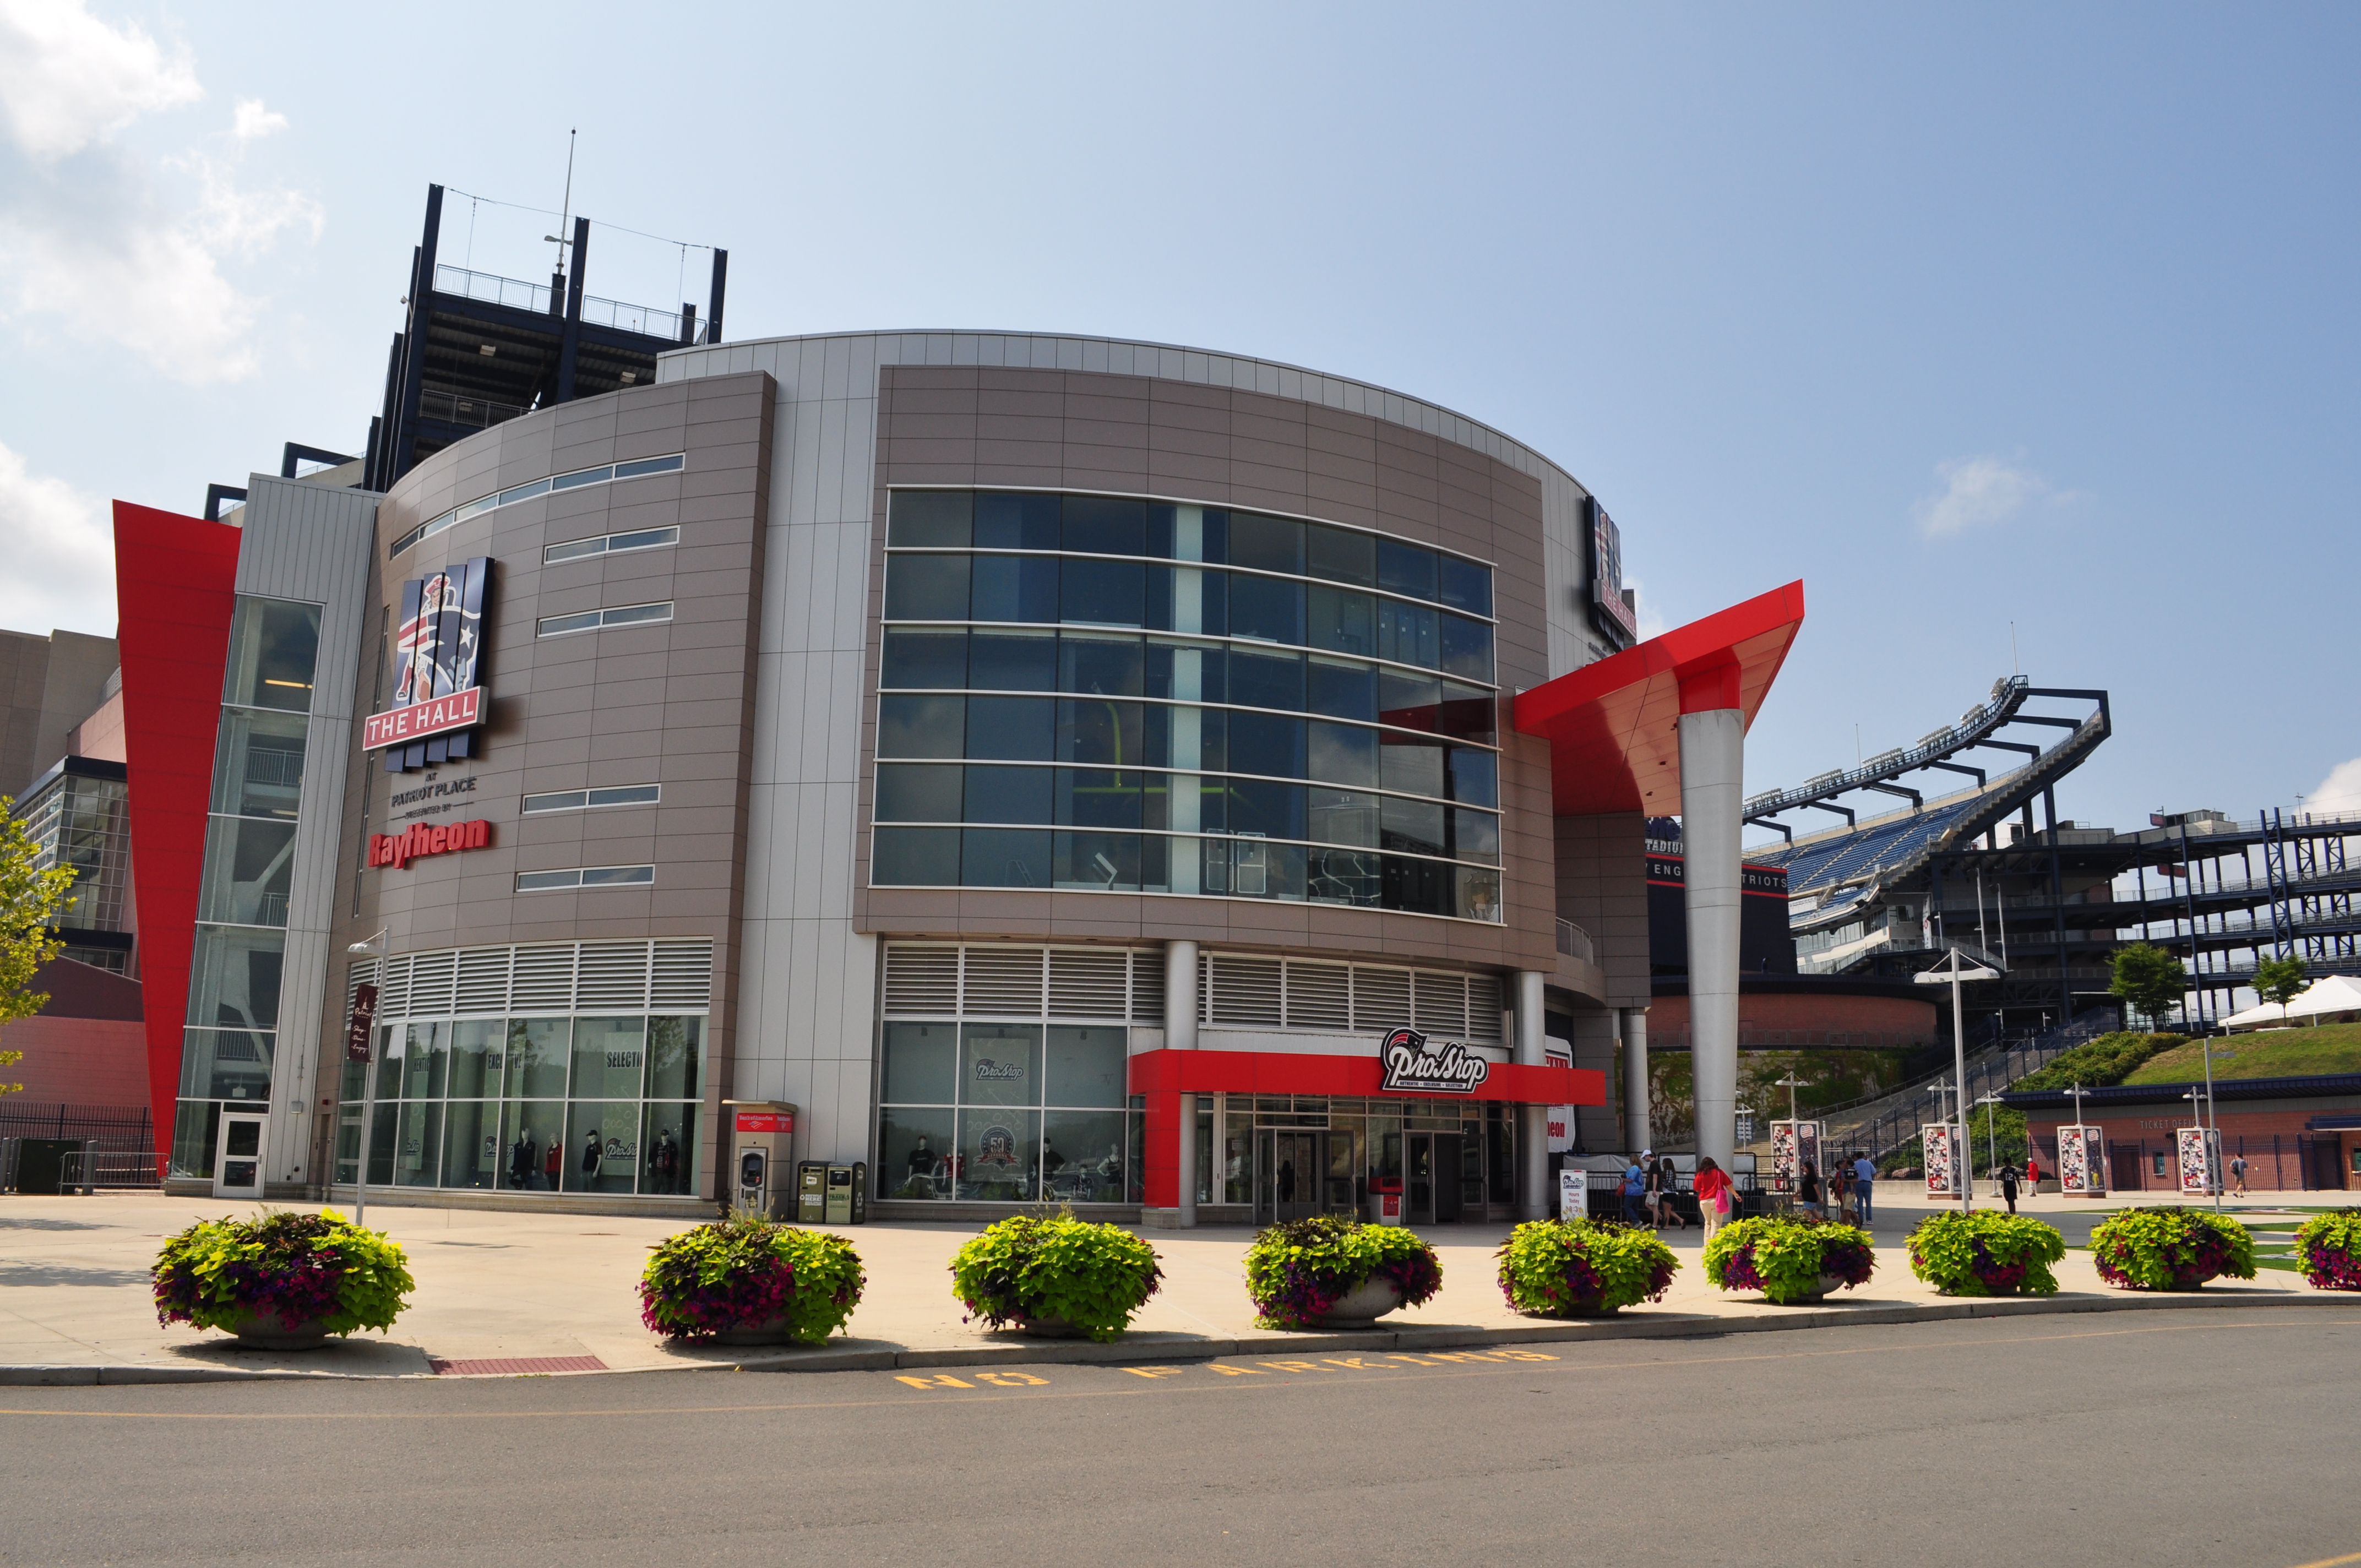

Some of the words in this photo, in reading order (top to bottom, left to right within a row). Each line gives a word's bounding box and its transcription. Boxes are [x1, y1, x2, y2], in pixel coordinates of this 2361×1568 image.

[1603, 585, 1617, 612] THE
[1619, 603, 1636, 633] HALL
[369, 712, 409, 742] THE
[415, 696, 474, 729] HALL
[390, 786, 434, 808] PATRIOT
[434, 776, 477, 797] PLACE
[425, 772, 438, 782] AT
[368, 819, 490, 869] Raytheon
[355, 1007, 372, 1017] Patriot
[2140, 1120, 2169, 1129] TICKET
[990, 1137, 1004, 1153] 50
[893, 1373, 1050, 1389] NO
[1119, 1350, 1561, 1379] PARKING
